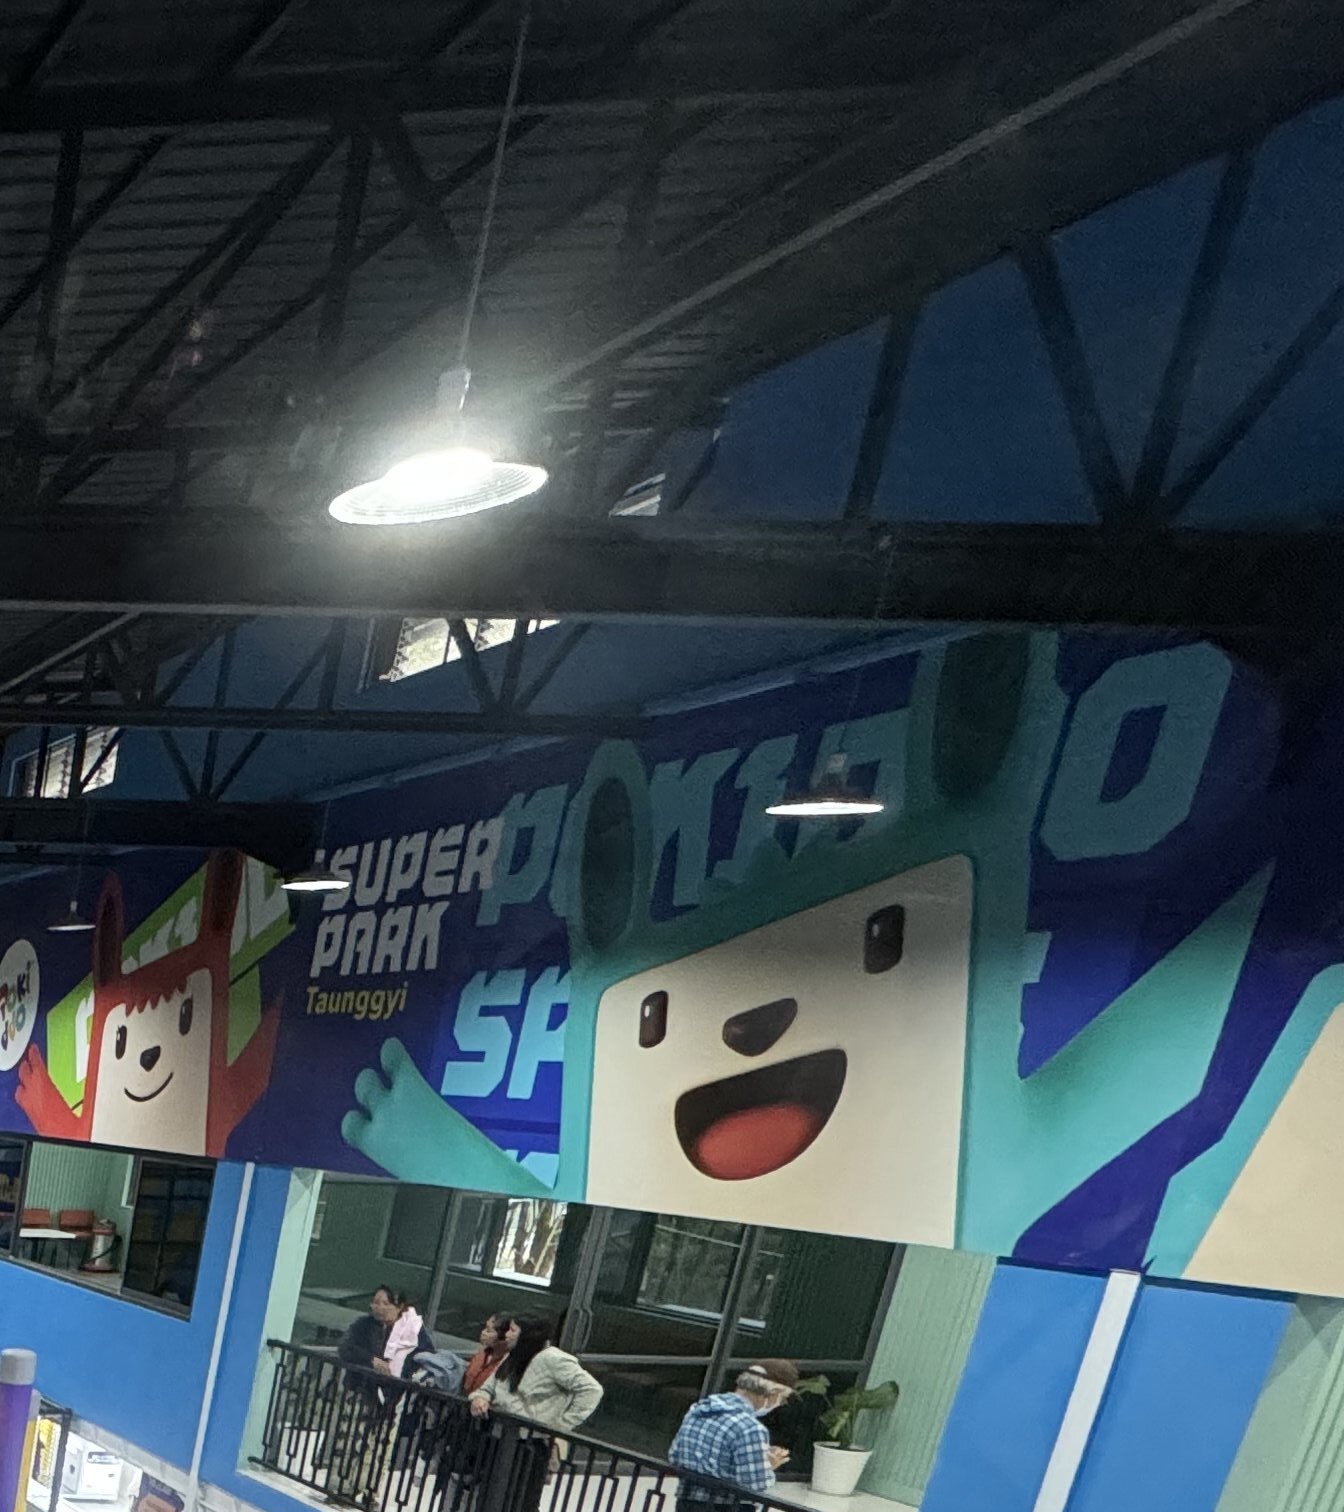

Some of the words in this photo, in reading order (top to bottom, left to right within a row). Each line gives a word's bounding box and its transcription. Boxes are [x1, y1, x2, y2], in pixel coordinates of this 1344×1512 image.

[319, 815, 506, 912] SUPER
[309, 901, 452, 979] PARK
[306, 981, 408, 1021] Taunggyi
